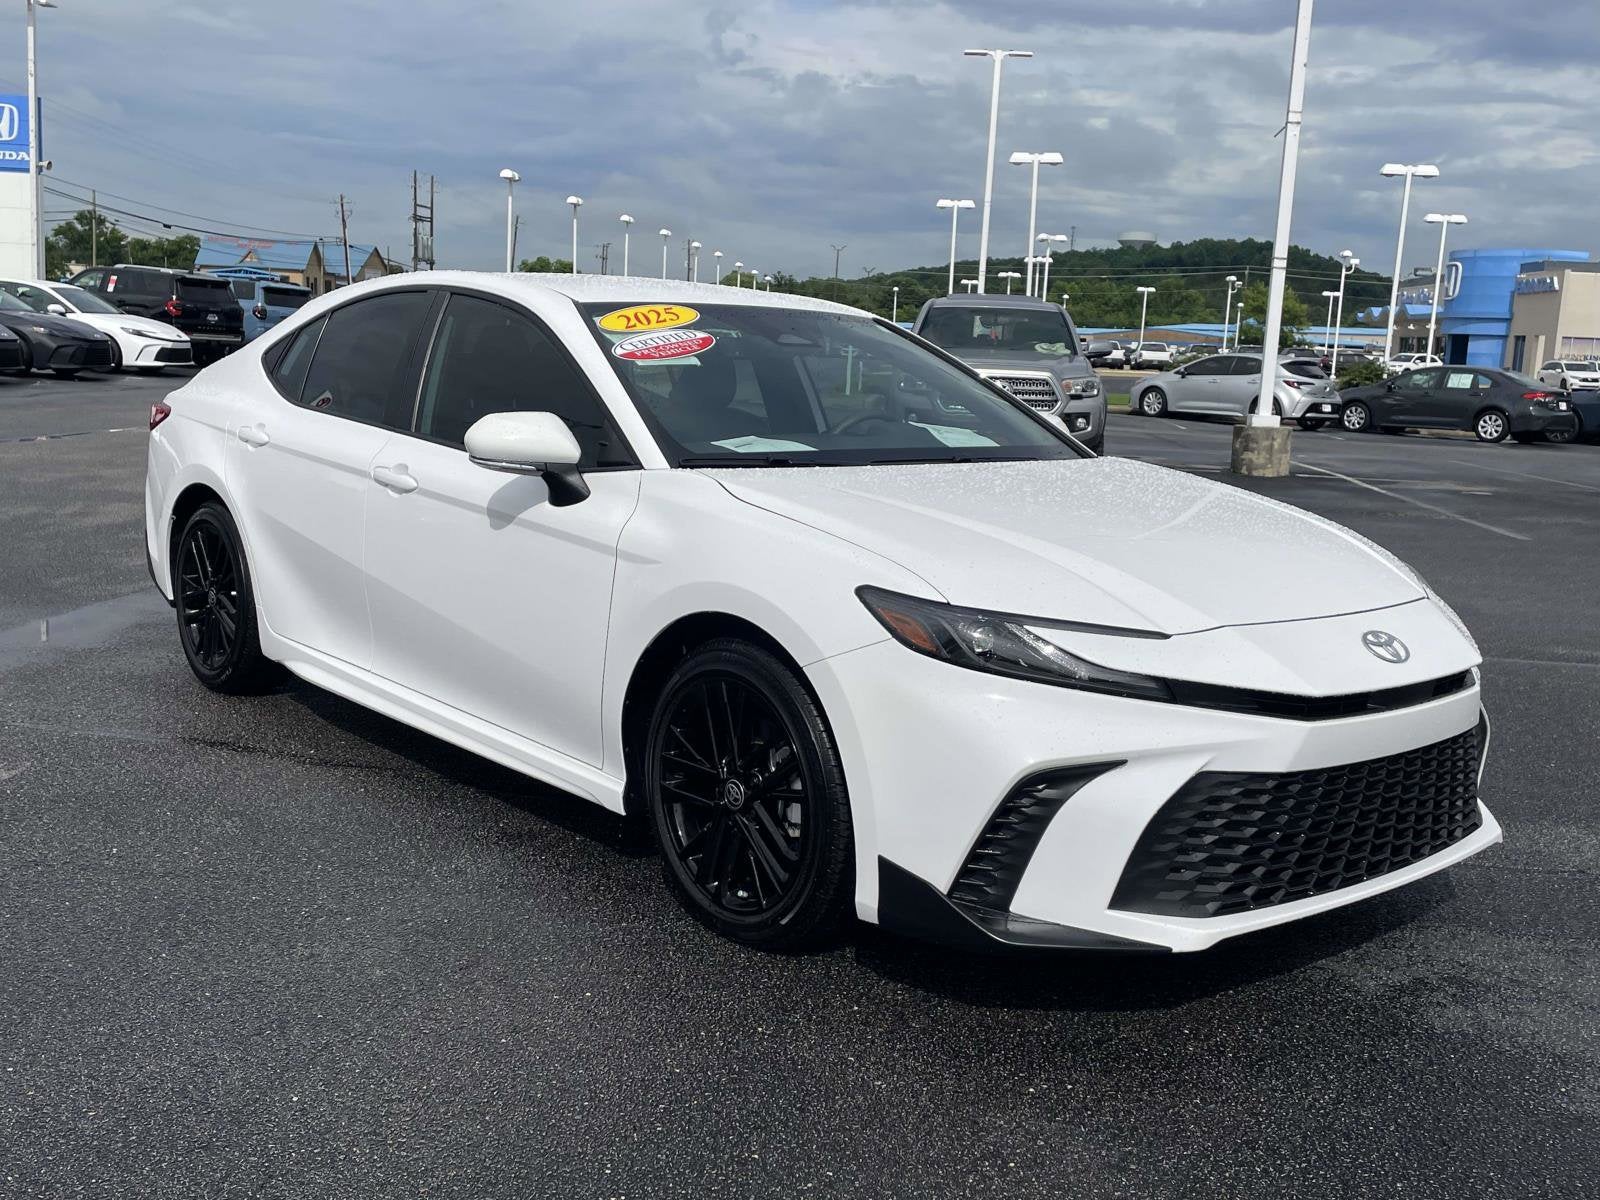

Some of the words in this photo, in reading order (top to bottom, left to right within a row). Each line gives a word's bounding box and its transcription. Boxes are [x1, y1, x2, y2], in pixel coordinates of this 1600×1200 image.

[617, 307, 680, 329] 2025
[620, 330, 697, 351] CERTIFIED
[635, 339, 703, 357] PRE-OWNED
[650, 345, 701, 358] VEHICLE
